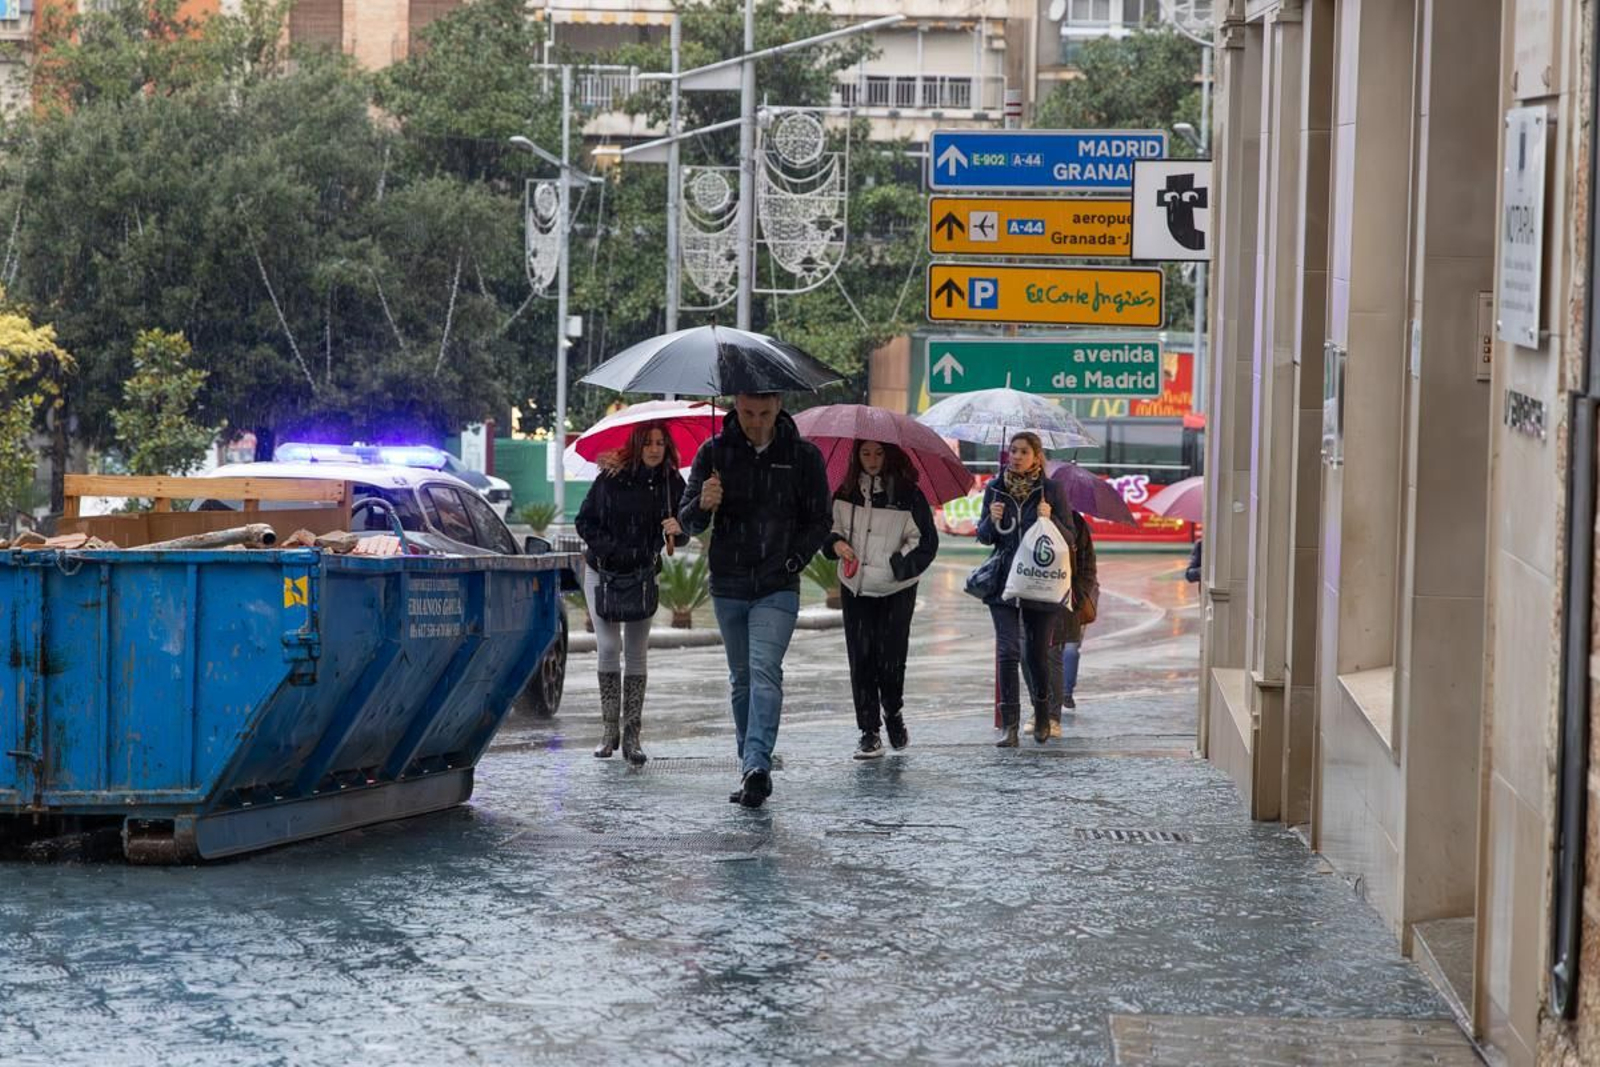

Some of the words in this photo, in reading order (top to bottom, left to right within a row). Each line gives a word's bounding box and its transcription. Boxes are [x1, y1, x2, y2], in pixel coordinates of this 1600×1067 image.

[1078, 140, 1160, 158] MADRID
[973, 154, 1005, 166] E-902
[1013, 154, 1042, 166] A-44
[1053, 163, 1133, 181] GRANA
[1009, 220, 1043, 234] A-44
[974, 281, 995, 306] P
[1026, 283, 1044, 303] El
[1046, 285, 1089, 304] Corte
[1073, 345, 1155, 363] avenida
[1052, 372, 1077, 388] de
[1084, 370, 1155, 388] Madrid
